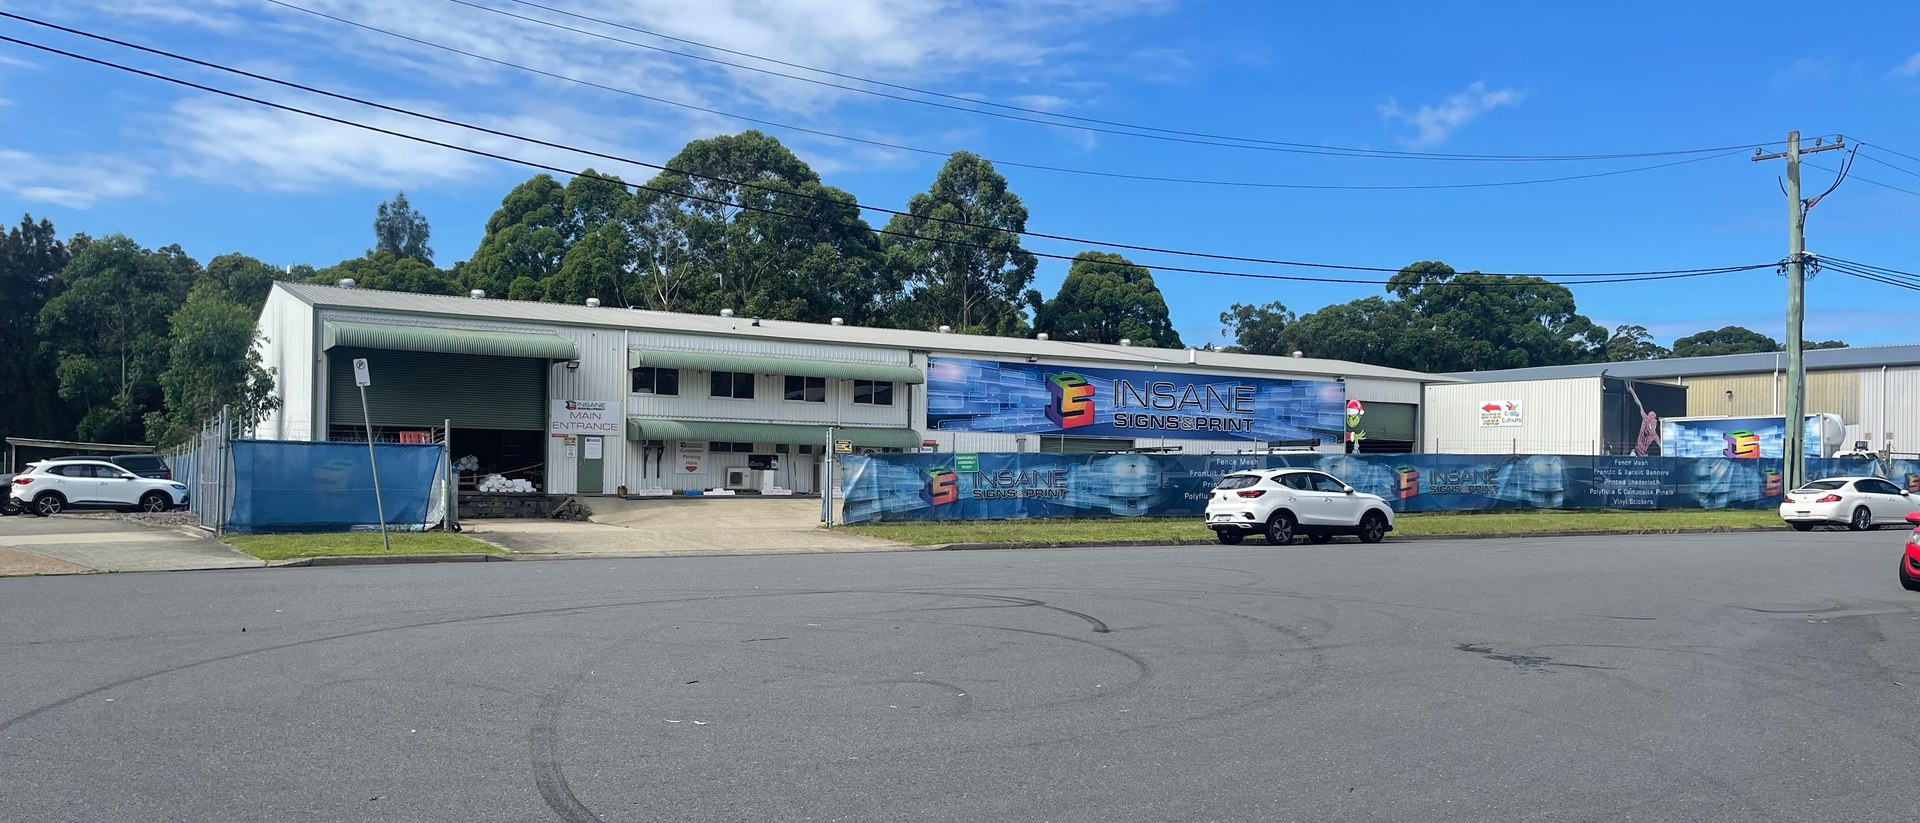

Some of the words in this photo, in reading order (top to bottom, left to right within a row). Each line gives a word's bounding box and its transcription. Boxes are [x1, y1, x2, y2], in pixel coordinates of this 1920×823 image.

[1113, 379, 1256, 413] INSANE
[570, 411, 602, 420] MAIN
[552, 421, 618, 431] ENTRANCE
[1216, 458, 1237, 466] Fence
[1240, 458, 1259, 466] Mesh
[1189, 469, 1218, 477] Frontlit
[1429, 468, 1499, 485] INSANE
[972, 469, 1068, 487] INSANE
[1184, 492, 1209, 501] Polyflu
[1612, 498, 1628, 506] Vinyl
